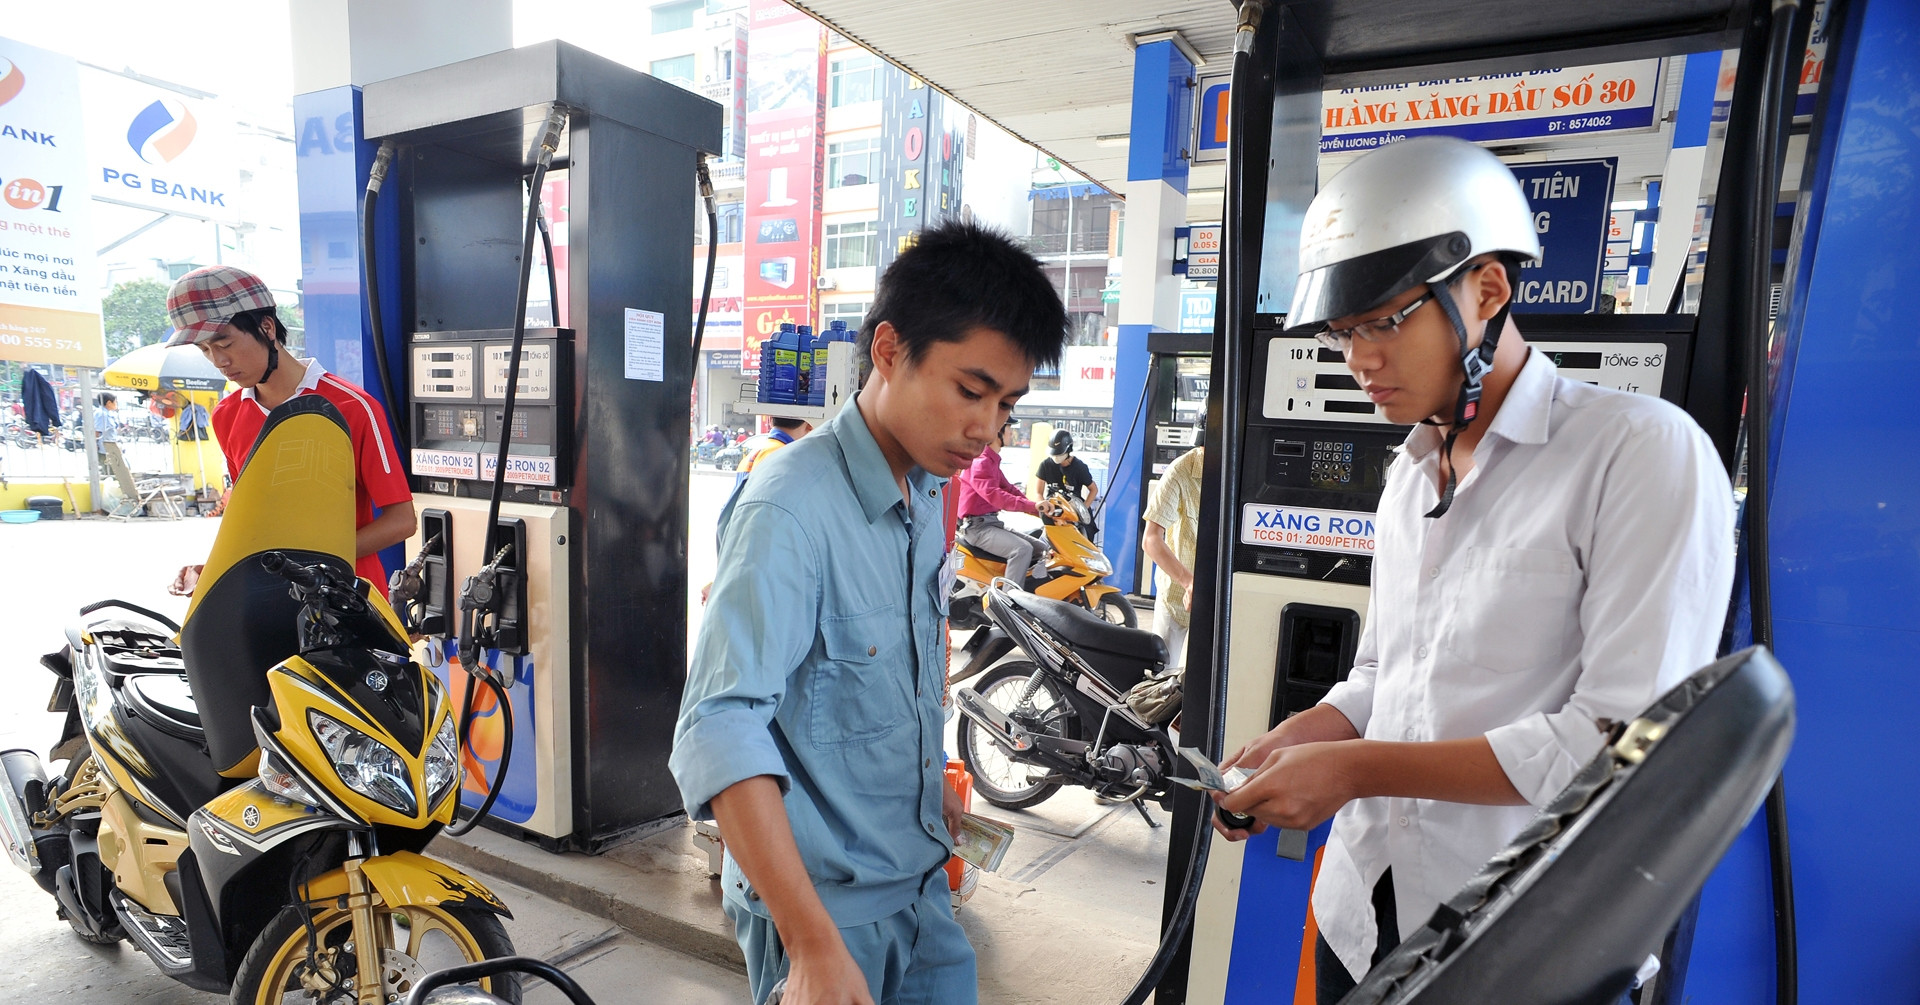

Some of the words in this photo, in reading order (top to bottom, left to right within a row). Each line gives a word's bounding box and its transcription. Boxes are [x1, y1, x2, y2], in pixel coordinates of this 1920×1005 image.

[1325, 98, 1397, 128] HÀNG
[1405, 93, 1480, 121] XĂNG
[1487, 80, 1545, 114] DẦU
[1552, 73, 1595, 109] SỐ
[1600, 78, 1637, 104] 30
[1548, 122, 1567, 132] ĐT:
[1569, 116, 1612, 130] 8574062
[1346, 138, 1377, 148] LƯƠNG
[103, 167, 141, 189] PG
[151, 178, 225, 207] BANK
[1532, 171, 1580, 199] TIÊN
[1200, 232, 1213, 240] DO
[1193, 241, 1211, 249] 0.05
[24, 252, 49, 263] mọi
[53, 256, 74, 266] nơi
[13, 264, 47, 280] Xăng
[1189, 267, 1217, 276] 20.800
[25, 283, 49, 293] tiên
[53, 285, 77, 296] tiến
[1512, 280, 1588, 304] ICARD
[25, 336, 52, 349] 555
[56, 339, 82, 351] 574
[1291, 349, 1302, 360] 10
[1306, 349, 1314, 360] X
[1604, 352, 1639, 367] TỔNG
[1644, 353, 1663, 367] SỐ
[131, 377, 148, 386] 099
[416, 452, 440, 465] XĂNG
[442, 455, 460, 467] RON
[463, 457, 473, 467] 92
[486, 457, 512, 471] XĂG
[515, 460, 536, 471] RON
[539, 462, 550, 472] 92
[1255, 508, 1321, 531] XĂNG
[1328, 517, 1375, 537] RON
[1253, 529, 1283, 542] TCCS
[1286, 532, 1303, 544] 01:
